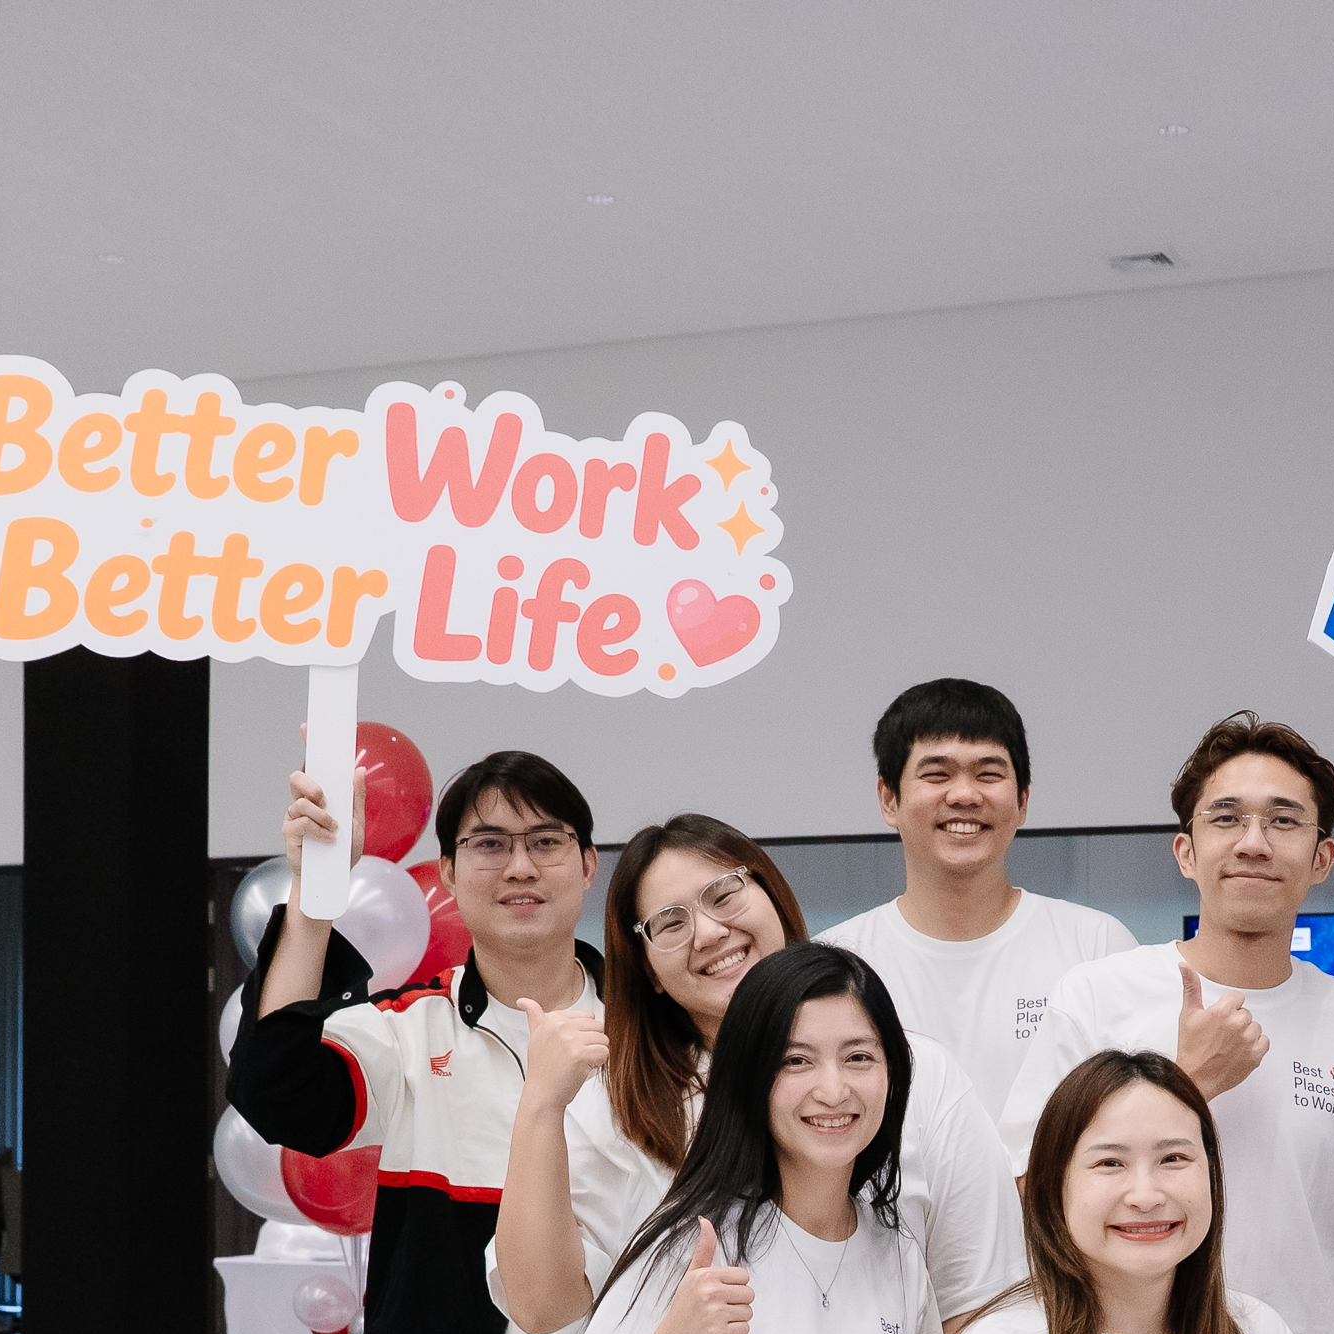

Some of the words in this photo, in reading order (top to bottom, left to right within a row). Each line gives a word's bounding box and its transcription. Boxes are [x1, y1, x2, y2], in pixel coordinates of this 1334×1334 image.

[385, 402, 702, 551] Work
[413, 544, 642, 677] Life
[1016, 996, 1049, 1010] Best
[1015, 1028, 1031, 1040] to
[1292, 1060, 1324, 1080] Best
[1293, 1093, 1309, 1107] to
